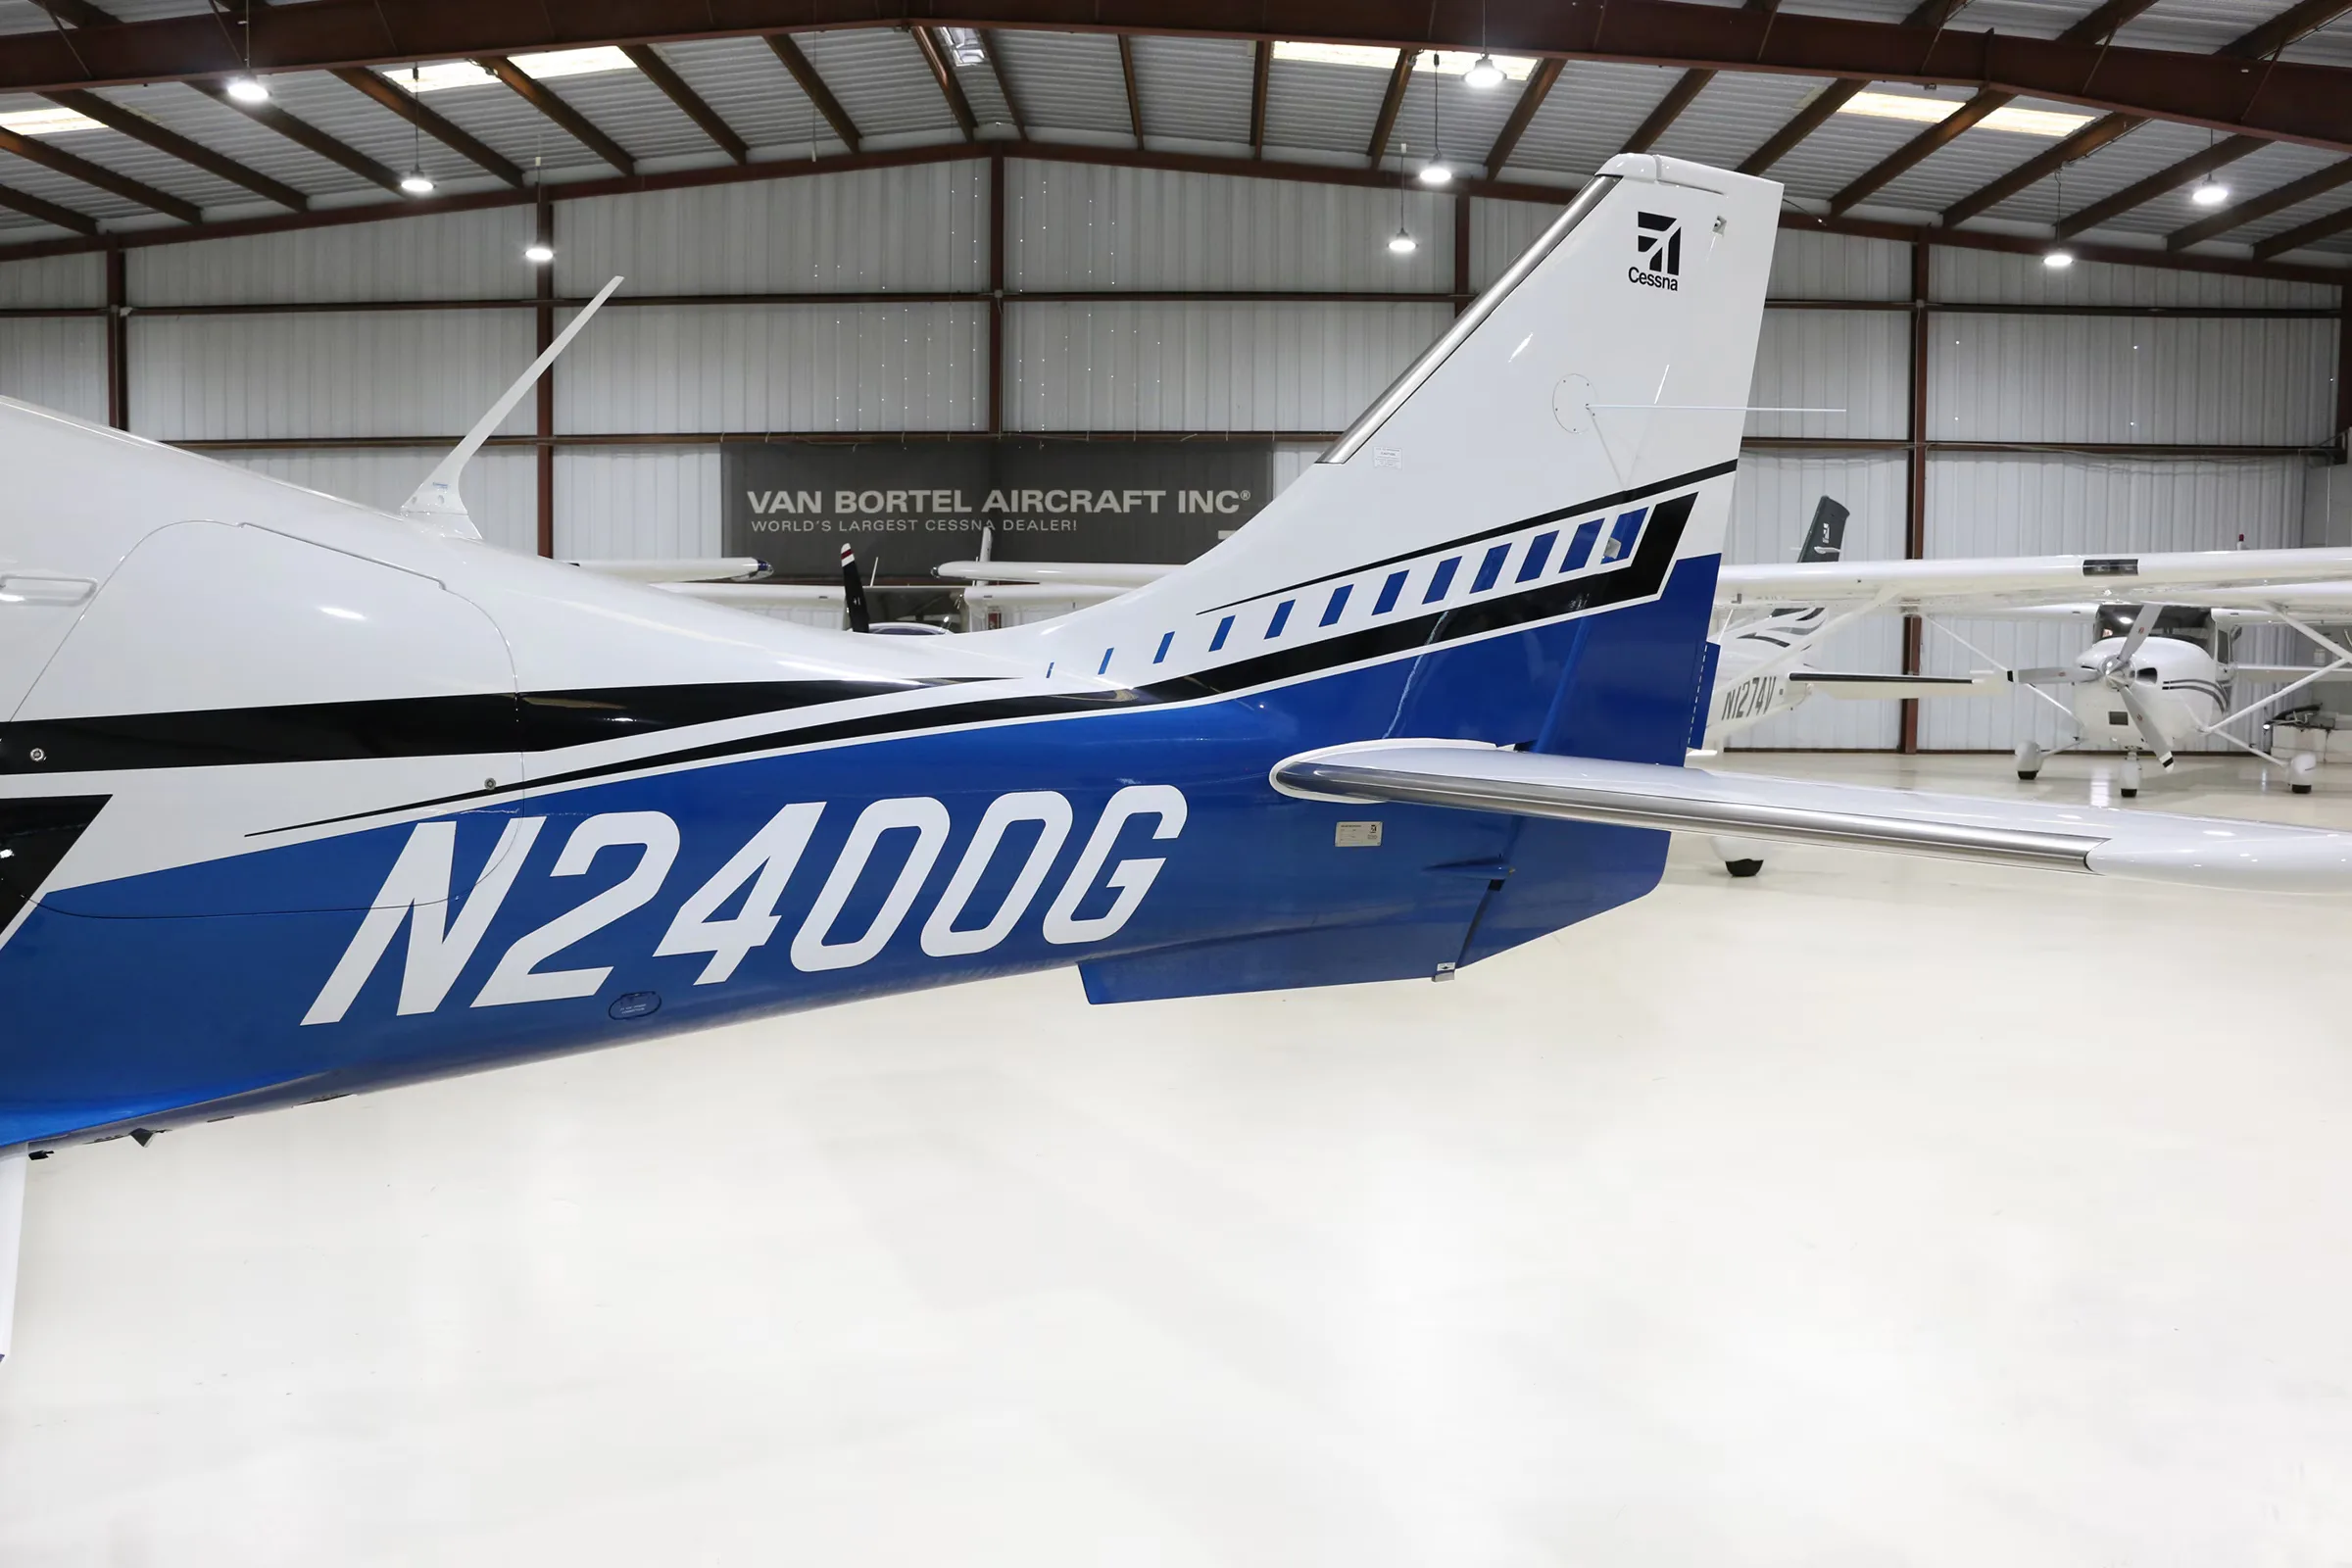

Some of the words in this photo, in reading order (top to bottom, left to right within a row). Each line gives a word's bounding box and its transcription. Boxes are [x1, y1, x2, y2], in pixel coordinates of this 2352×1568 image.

[1628, 266, 1679, 292] Cessna
[747, 490, 822, 514] VAN
[835, 489, 973, 514] BORTEL
[981, 489, 1167, 514] AIRCRAFT
[751, 519, 832, 532] WORLD'S
[839, 519, 918, 531] LARGEST
[925, 518, 997, 531] CESSNA
[1003, 519, 1077, 531] DEALER!
[1721, 675, 1777, 721] N1274V
[300, 784, 1189, 1027] N2400G
